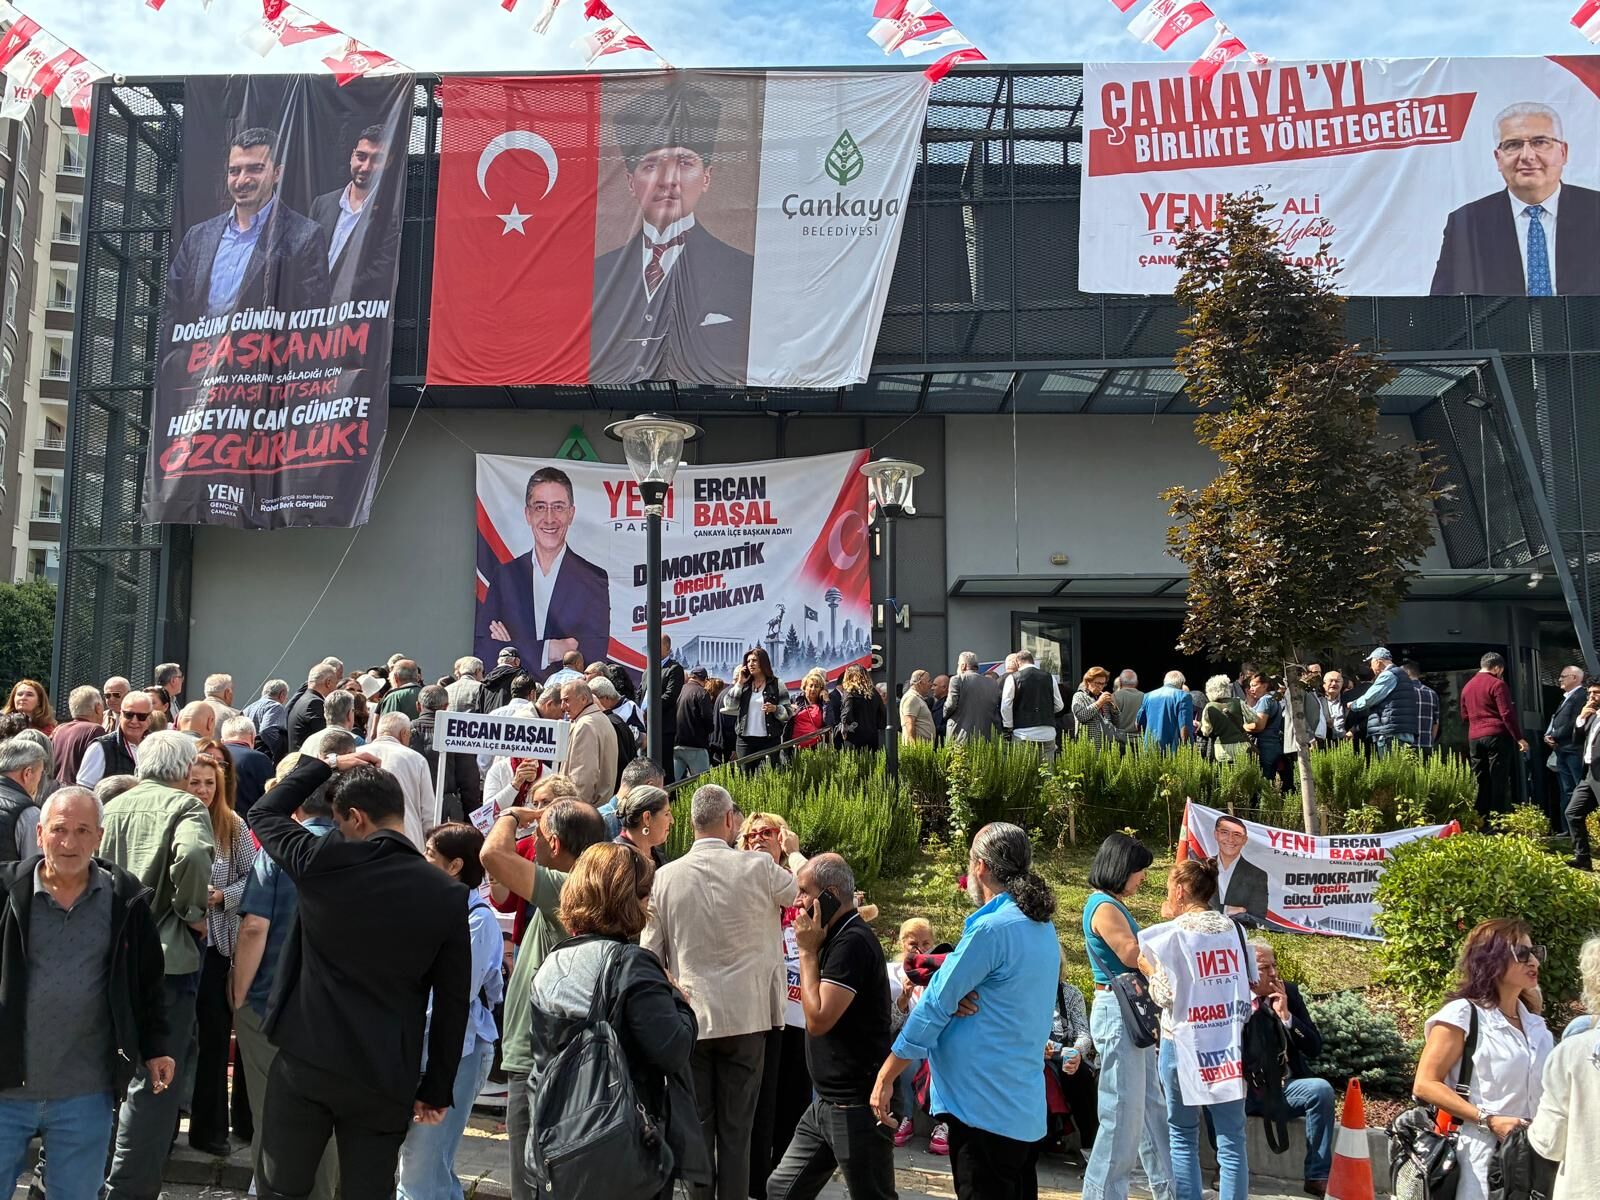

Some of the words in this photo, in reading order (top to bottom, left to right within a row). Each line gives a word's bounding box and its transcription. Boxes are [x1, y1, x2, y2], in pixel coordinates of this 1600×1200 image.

[1101, 60, 1368, 146] ÇANKAYA'YI
[1134, 125, 1250, 164] BİRLİKTE
[1261, 101, 1448, 153] YÖNETECEĞİZ!
[781, 192, 899, 221] Çankaya
[1282, 194, 1320, 215] ALİ
[802, 224, 878, 236] BELEDİYESİ
[1138, 255, 1178, 267] ÇANK
[171, 313, 229, 343] DOĞUM
[230, 305, 286, 332] GÜNÜN
[288, 305, 338, 330] KUTLU
[339, 300, 390, 321] OLSUN
[186, 322, 370, 374] BAŞKANIM
[203, 374, 229, 387] KAMU
[167, 404, 249, 437] HÜSEYİN
[253, 406, 289, 431] CAN
[159, 421, 369, 472] ÖZGÜRLÜK!
[207, 483, 244, 504] YENİ
[602, 480, 674, 519] YEİ
[694, 476, 767, 502] ERCAN
[295, 500, 327, 510] Görgülü
[693, 501, 778, 529] BAŞAL
[614, 521, 670, 532] PARİ
[693, 530, 726, 539] ÇANKAYA
[727, 528, 741, 538] İLÇE
[742, 529, 770, 537] BAŞKAN
[633, 541, 765, 587] DMOKRATİK
[673, 573, 727, 596] ÖRGÜT,
[632, 595, 687, 624] GLÜ
[689, 583, 765, 616] ÇANKAYA
[447, 719, 502, 741] ERCAN
[504, 723, 556, 746] BAŞAL
[445, 739, 481, 748] ÇANKAYA
[482, 741, 499, 750] İLÇE
[500, 744, 532, 753] BAŞKAN
[533, 746, 556, 754] ADAYI
[1267, 830, 1316, 854] YENİ
[1329, 837, 1382, 848] ERCAN
[1285, 869, 1379, 886] DEMOKRATİK
[1283, 893, 1321, 906] GÜÇLÜ
